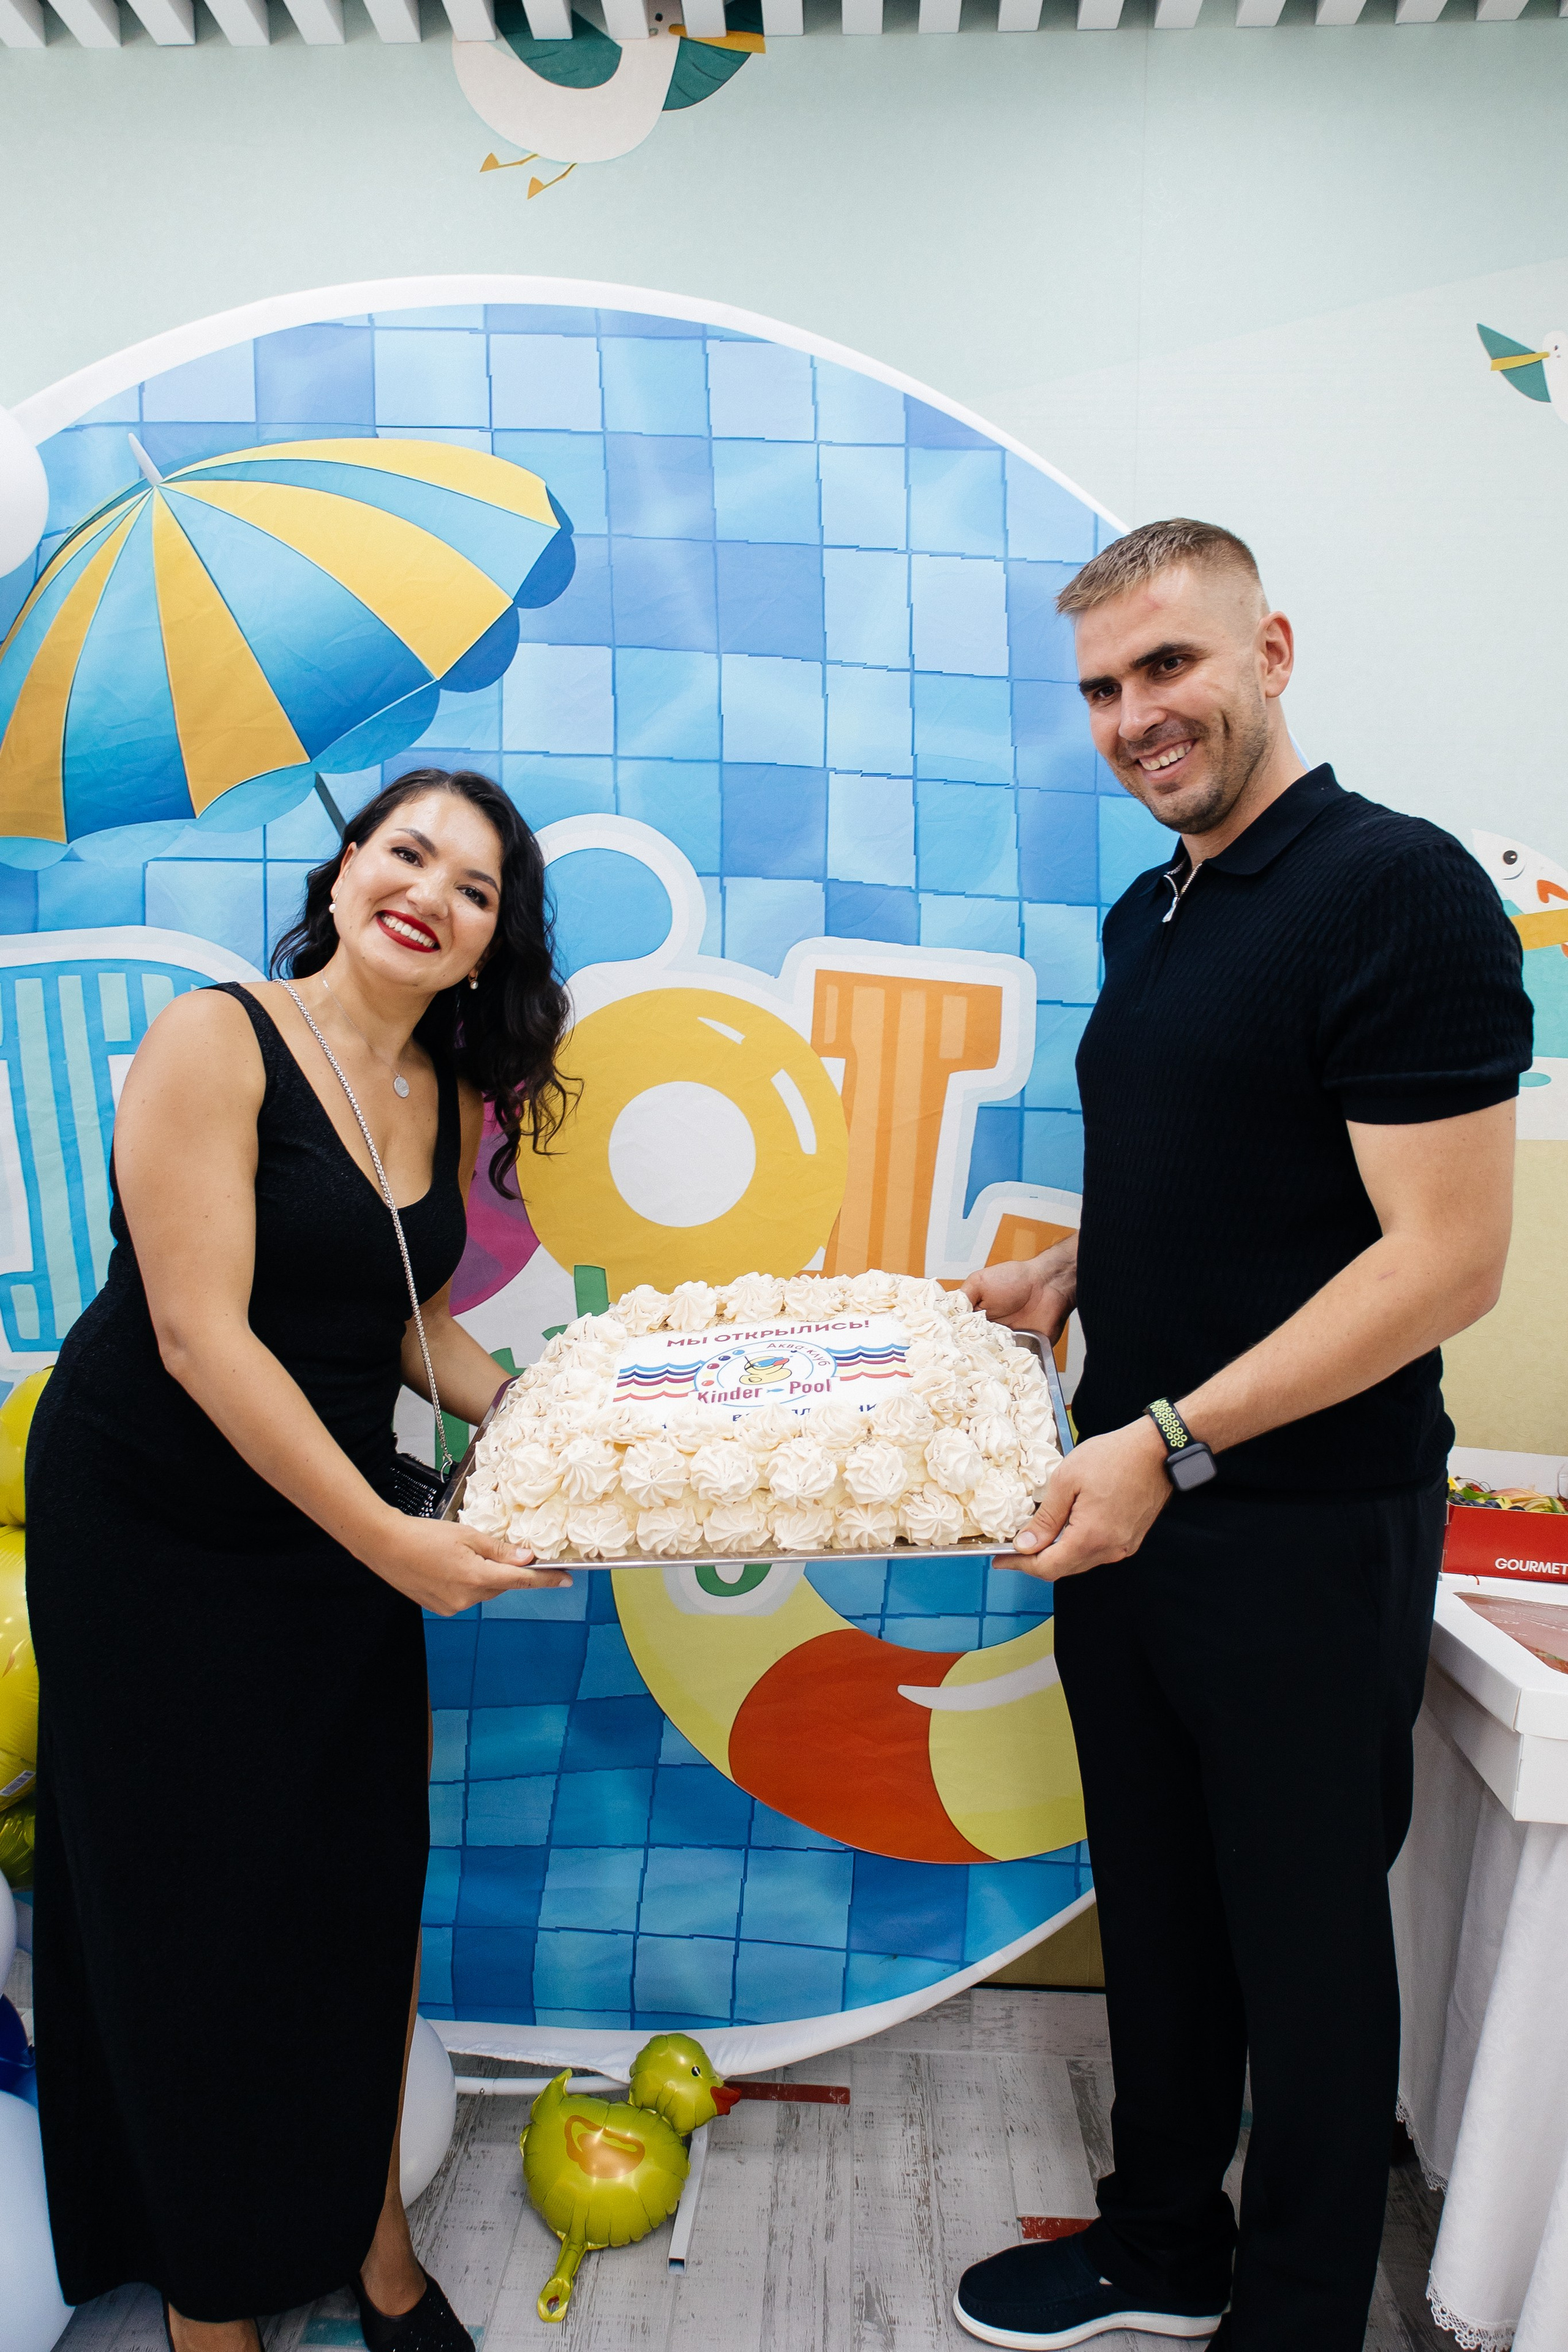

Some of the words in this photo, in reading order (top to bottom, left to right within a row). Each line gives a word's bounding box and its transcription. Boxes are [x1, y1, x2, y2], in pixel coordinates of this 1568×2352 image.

[667, 1337, 707, 1347] МЫ
[714, 1320, 869, 1342] ОТКРЫЛИСЬ!
[697, 1387, 763, 1404] Kinder
[789, 1379, 832, 1395] Pool
[1495, 1558, 1568, 1574] GOURMET
